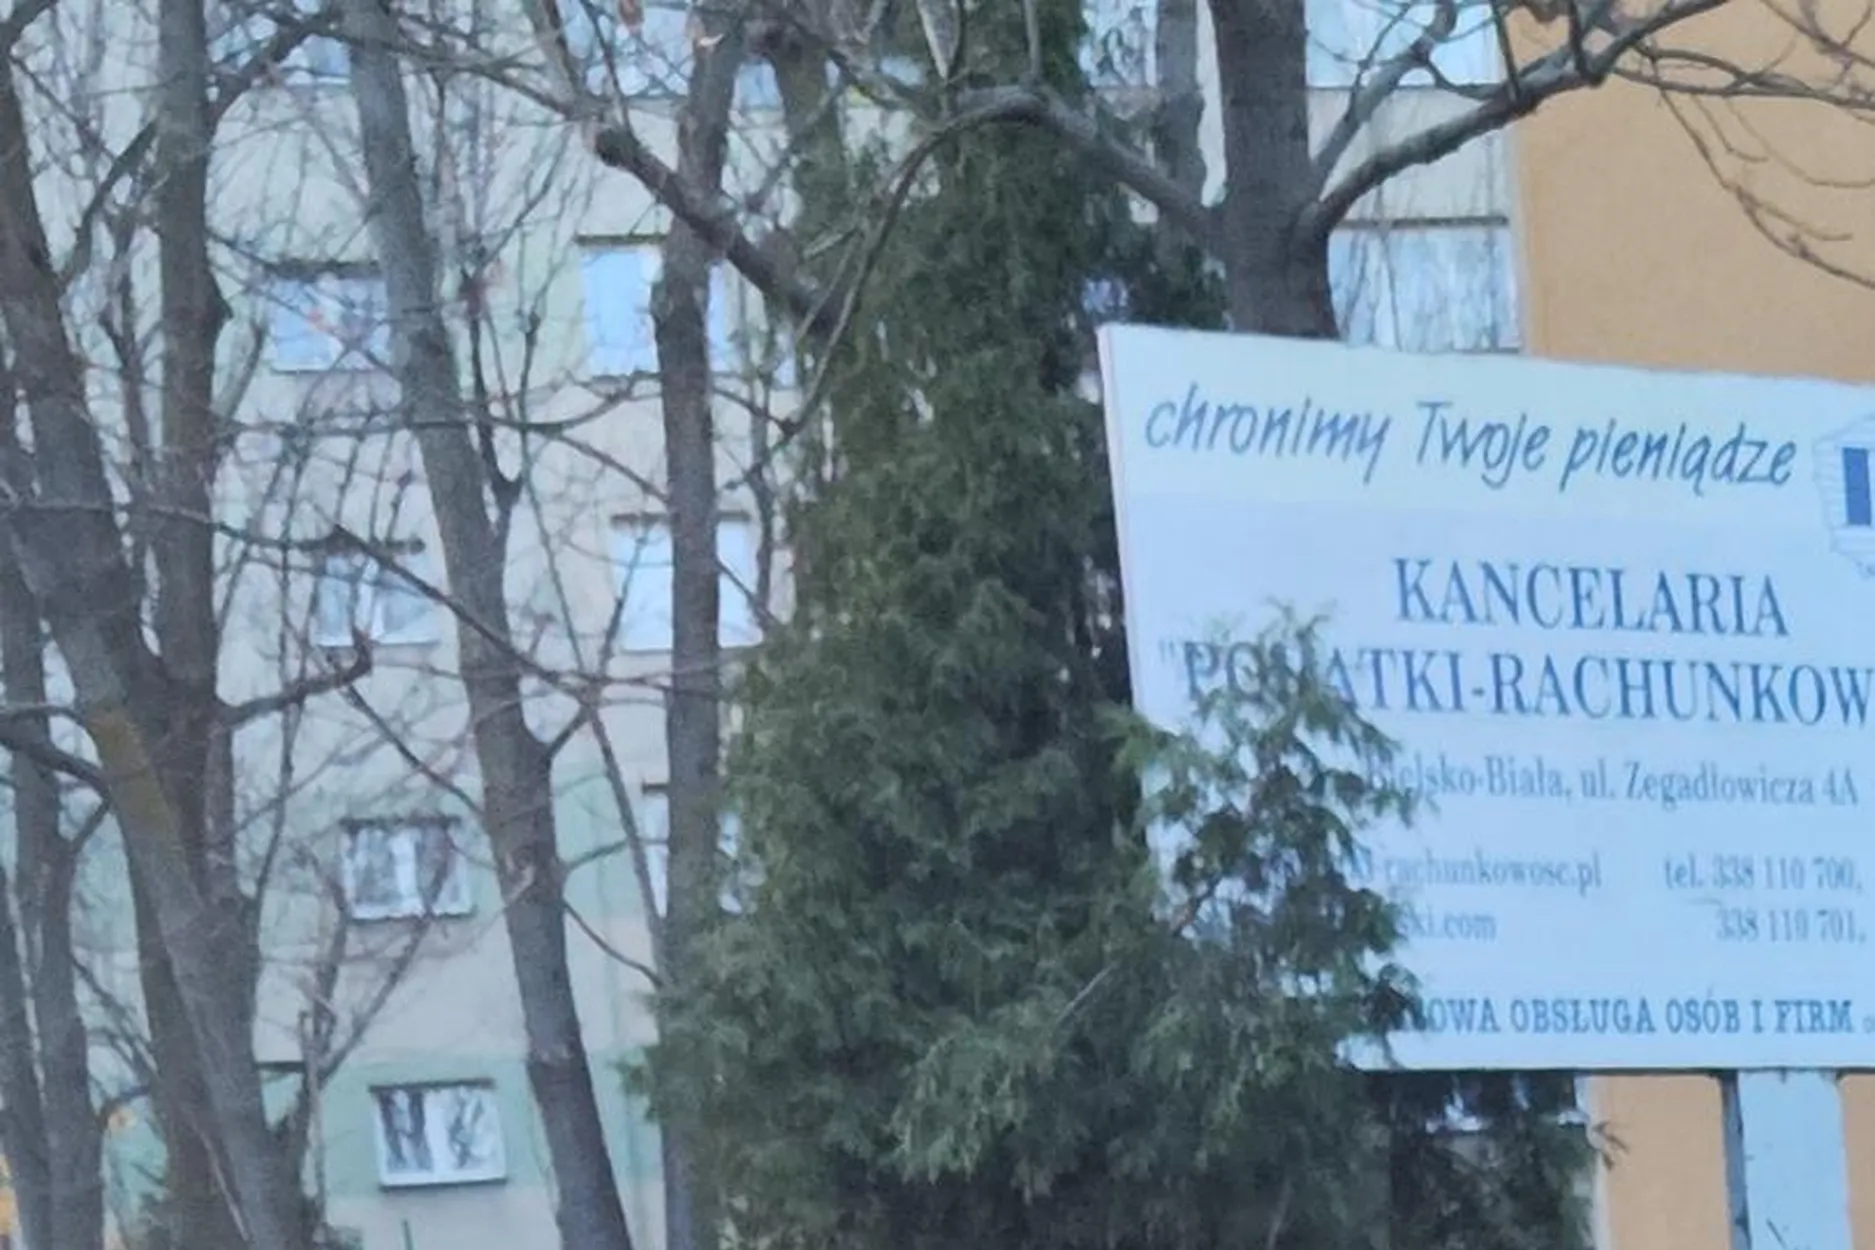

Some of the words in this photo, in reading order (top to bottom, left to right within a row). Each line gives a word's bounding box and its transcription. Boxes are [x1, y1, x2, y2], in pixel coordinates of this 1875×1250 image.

[1145, 382, 1392, 485] chronimy
[1415, 400, 1552, 490] Twoje
[1558, 418, 1798, 496] pieniądze
[1393, 556, 1790, 637] KANCELARIA
[1578, 757, 1616, 798] ul.
[1624, 758, 1816, 812] Zegadłowicza
[1823, 767, 1859, 806] 4A
[1664, 852, 1704, 889] tel.
[1712, 854, 1756, 890] 338
[1764, 856, 1806, 891] 110
[1716, 906, 1760, 942] 338
[1767, 909, 1810, 943] 110
[1510, 996, 1657, 1036] OBSŁUGA
[1665, 990, 1741, 1035] OSÓB
[1773, 999, 1856, 1035] FIRM
